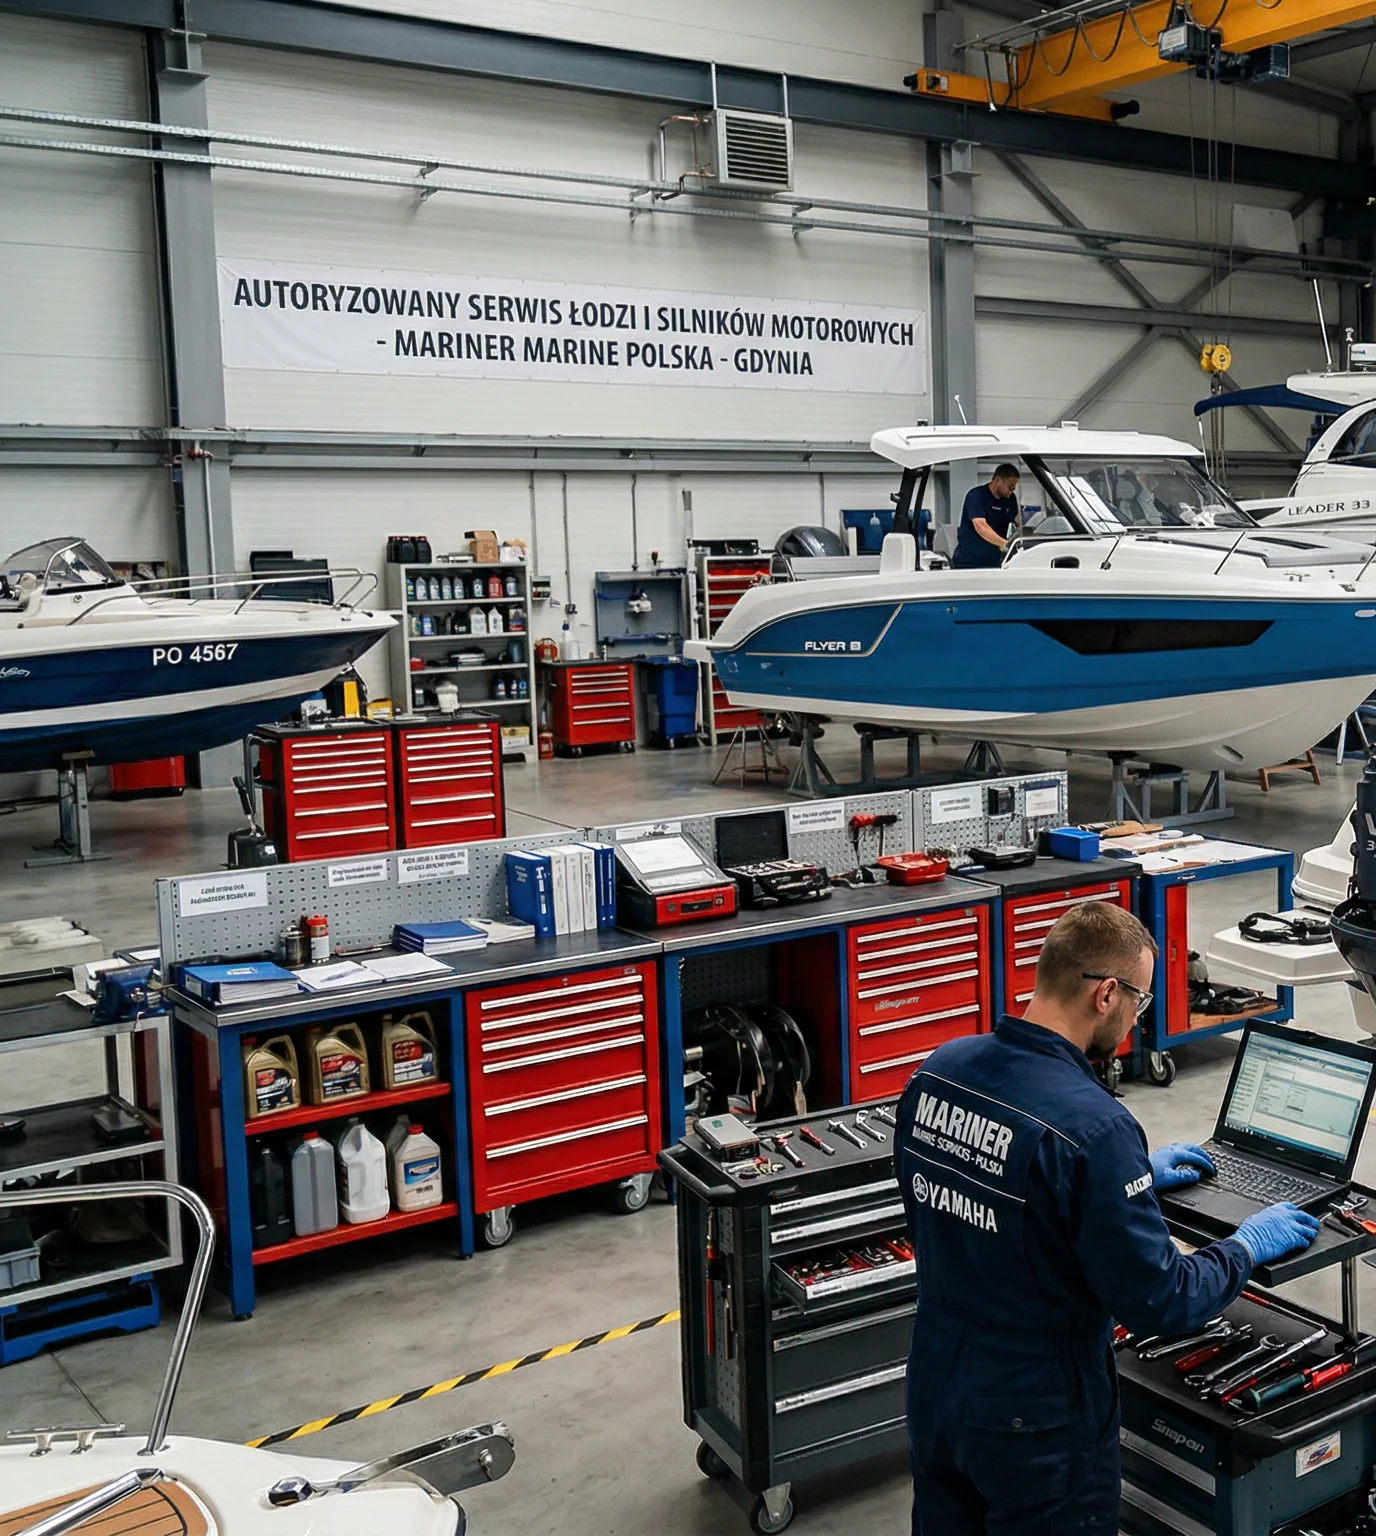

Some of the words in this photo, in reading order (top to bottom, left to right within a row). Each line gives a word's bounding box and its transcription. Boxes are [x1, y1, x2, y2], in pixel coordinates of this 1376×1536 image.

[234, 278, 461, 319] AUTORYZOWANY
[469, 294, 562, 325] SERWIS
[569, 301, 637, 329] ŁODZI
[644, 305, 650, 330] I
[657, 306, 765, 337] SILNIKÓW
[771, 314, 914, 346] MOTOROWYCH
[394, 329, 515, 361] MARINER
[523, 336, 619, 366] MARINE
[626, 341, 714, 370] POLSKA
[734, 348, 813, 376] GDYNIA
[1288, 502, 1345, 516] LEADER
[1351, 500, 1370, 510] 33
[152, 647, 182, 666] PO
[189, 643, 238, 662] 4567
[804, 641, 846, 651] FLYER
[914, 1091, 1014, 1162] MARINER
[928, 1181, 998, 1233] YAMAHA
